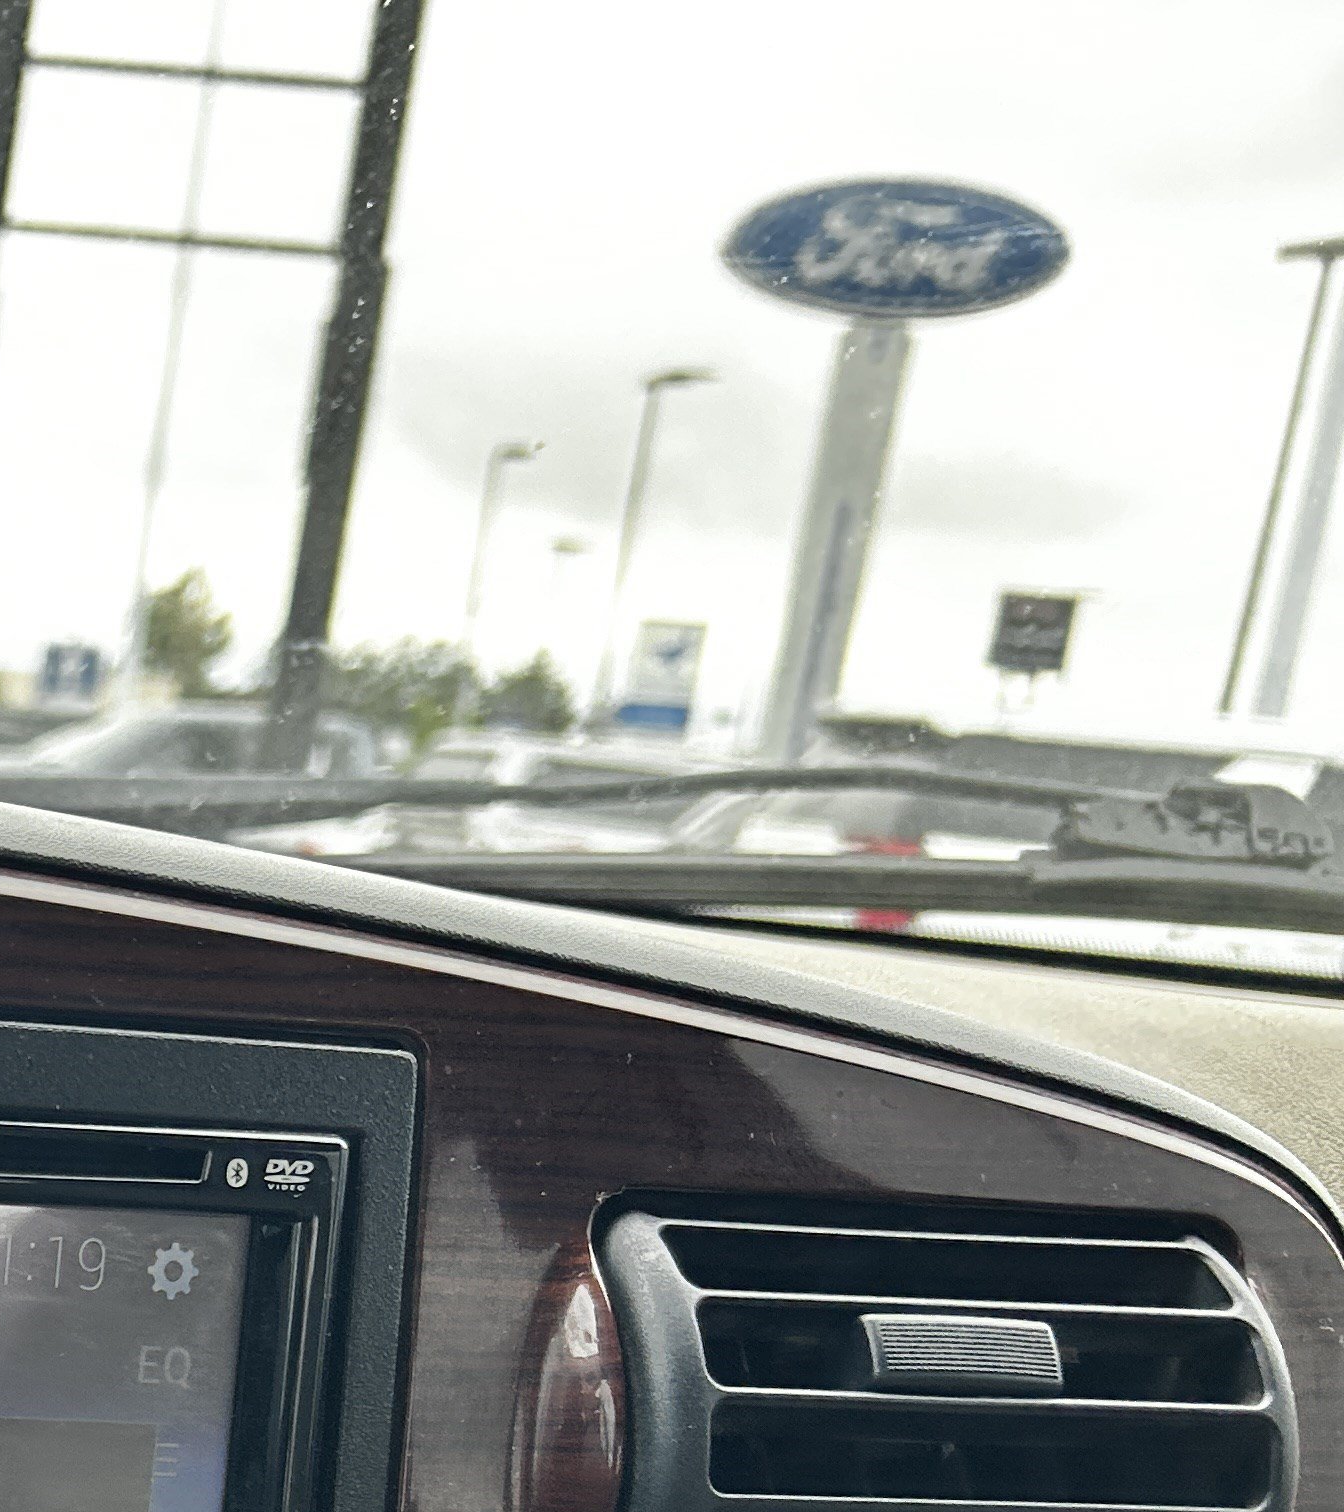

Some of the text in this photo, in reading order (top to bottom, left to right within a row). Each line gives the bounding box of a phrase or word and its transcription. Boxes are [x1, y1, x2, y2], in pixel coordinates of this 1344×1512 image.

[795, 197, 1005, 291] Ford
[265, 1158, 315, 1176] DVD
[267, 1183, 306, 1192] VIDEO
[0, 1235, 107, 1292] 1:19
[138, 1345, 193, 1390] EQ
